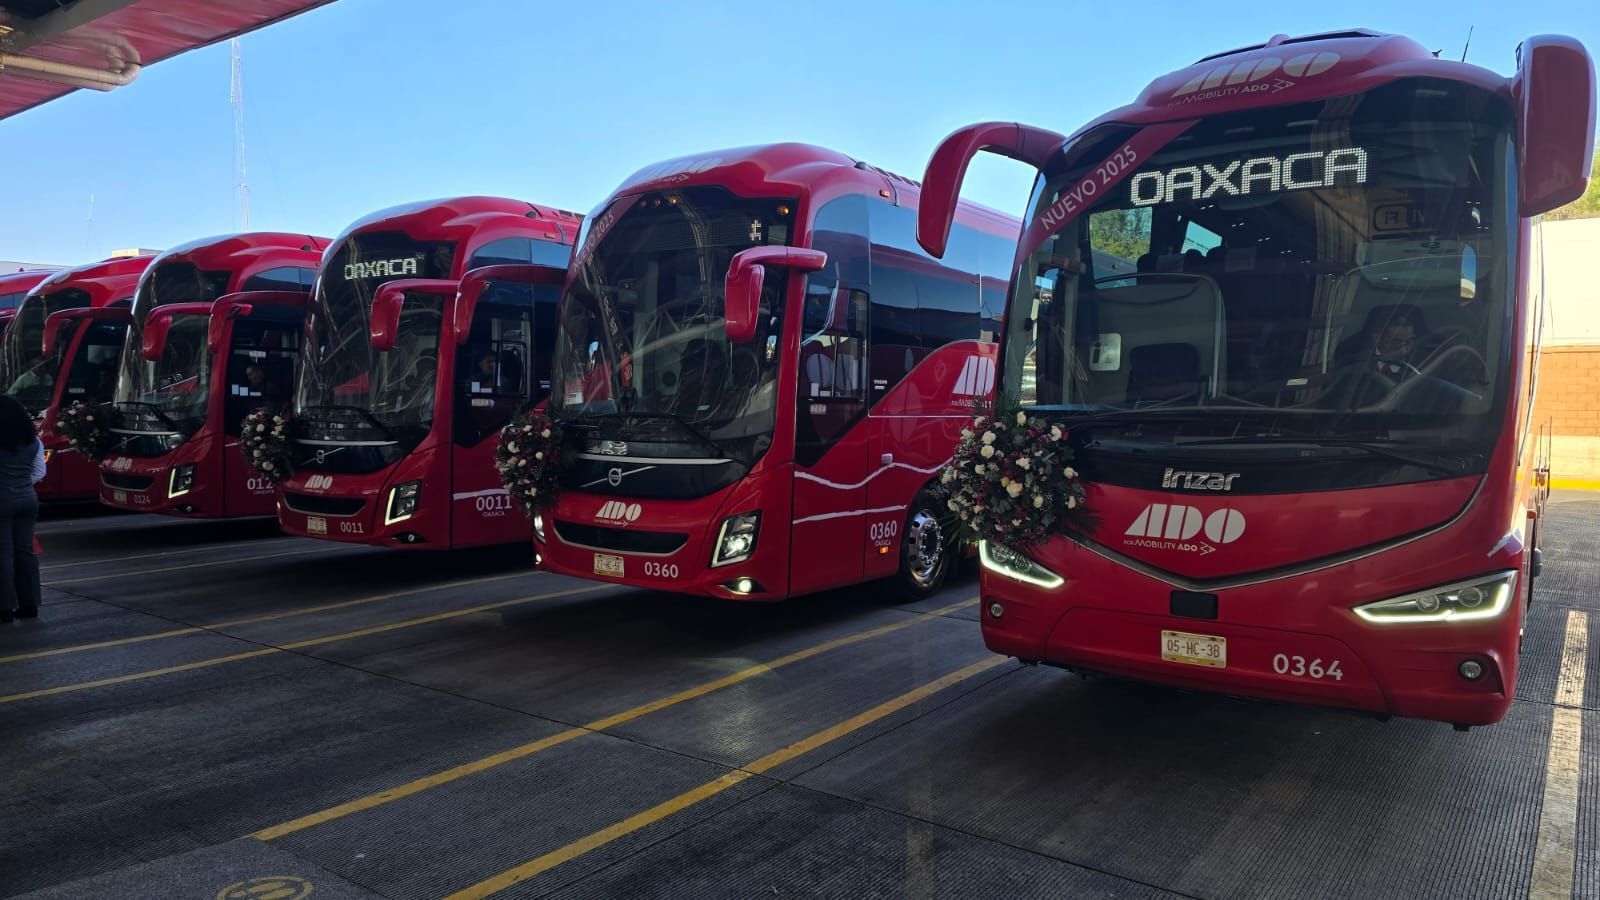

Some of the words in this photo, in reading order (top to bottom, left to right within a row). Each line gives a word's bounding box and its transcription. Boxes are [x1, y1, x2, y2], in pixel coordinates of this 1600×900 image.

[1171, 52, 1341, 97] ADO
[1182, 87, 1240, 104] MOBILITY
[1241, 83, 1270, 94] ADO
[1130, 147, 1368, 206] OAXACA
[1041, 181, 1097, 231] NUEVO
[1096, 145, 1138, 186] 2025
[573, 234, 596, 273] NUEVO
[596, 211, 614, 238] 2025
[344, 257, 417, 280] OAXACA
[952, 355, 996, 397] AD
[247, 478, 274, 490] 012
[304, 475, 334, 490] ADO
[133, 494, 151, 505] 0124
[475, 495, 513, 511] 0011
[595, 500, 642, 522] ADO
[340, 521, 364, 534] 0011
[870, 520, 897, 540] 0360
[1124, 503, 1246, 544] ADO
[1134, 539, 1176, 550] MOBILITY
[1177, 543, 1198, 552] ADO
[644, 561, 679, 578] 0360
[1167, 639, 1220, 658] 05-HC-3B
[1273, 653, 1343, 681] 0364
